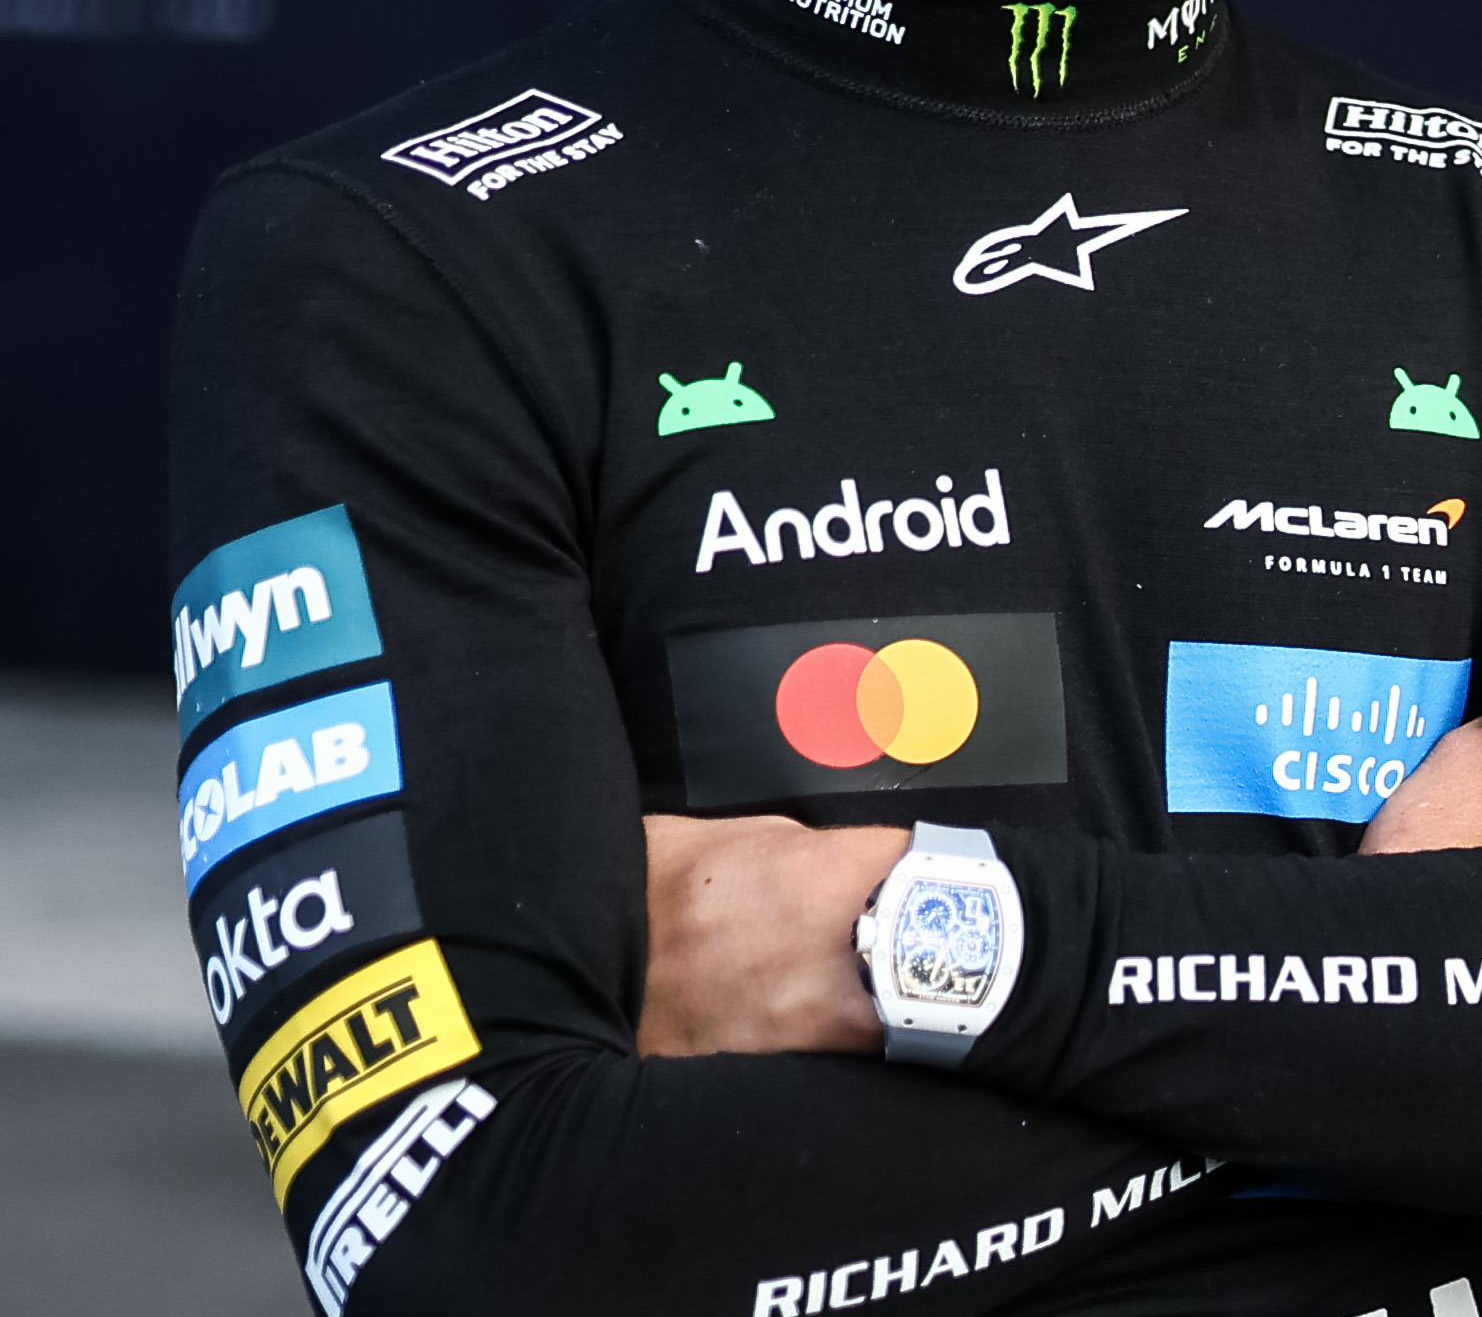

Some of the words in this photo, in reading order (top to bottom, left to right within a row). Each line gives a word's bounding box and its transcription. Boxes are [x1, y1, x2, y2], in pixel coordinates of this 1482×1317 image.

[410, 107, 573, 168] Hilton
[467, 165, 524, 202] FOR
[514, 150, 569, 174] THE
[562, 123, 624, 161] STAY
[1325, 137, 1381, 157] FOR
[1390, 145, 1447, 169] THE
[695, 468, 1011, 574] Android
[1203, 498, 1450, 548] McLaren
[1265, 555, 1371, 581] FORMULA
[1381, 563, 1391, 581] 1
[1400, 564, 1449, 586] TEAM
[174, 564, 332, 713] llwyn
[180, 723, 370, 862] COLAB
[206, 869, 354, 1025] okta
[1107, 954, 1416, 1006] RICHARD
[1090, 1156, 1227, 1229] MILL
